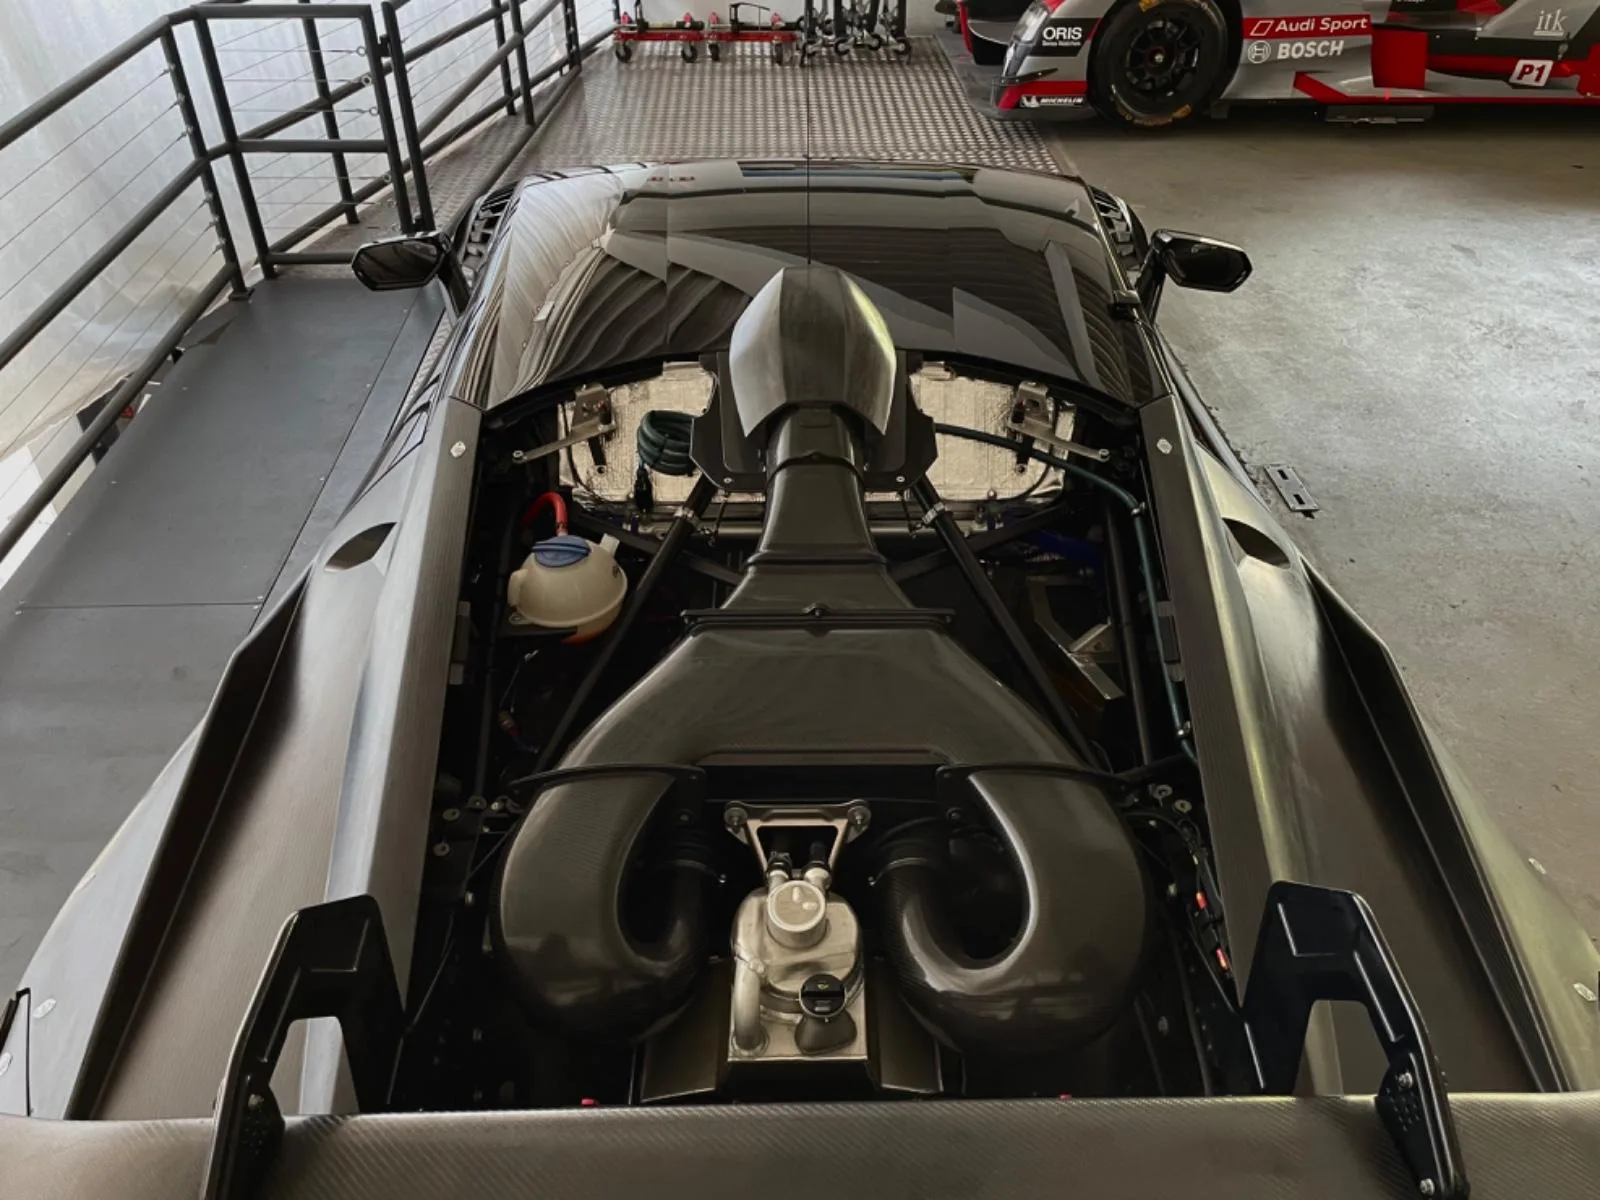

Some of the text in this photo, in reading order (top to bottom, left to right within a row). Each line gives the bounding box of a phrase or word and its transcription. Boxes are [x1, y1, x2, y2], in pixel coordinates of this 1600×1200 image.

[1043, 27, 1082, 40] ORIS
[1275, 17, 1369, 33] Audi Sport
[1277, 40, 1344, 60] BOSCH
[1517, 64, 1547, 82] P1
